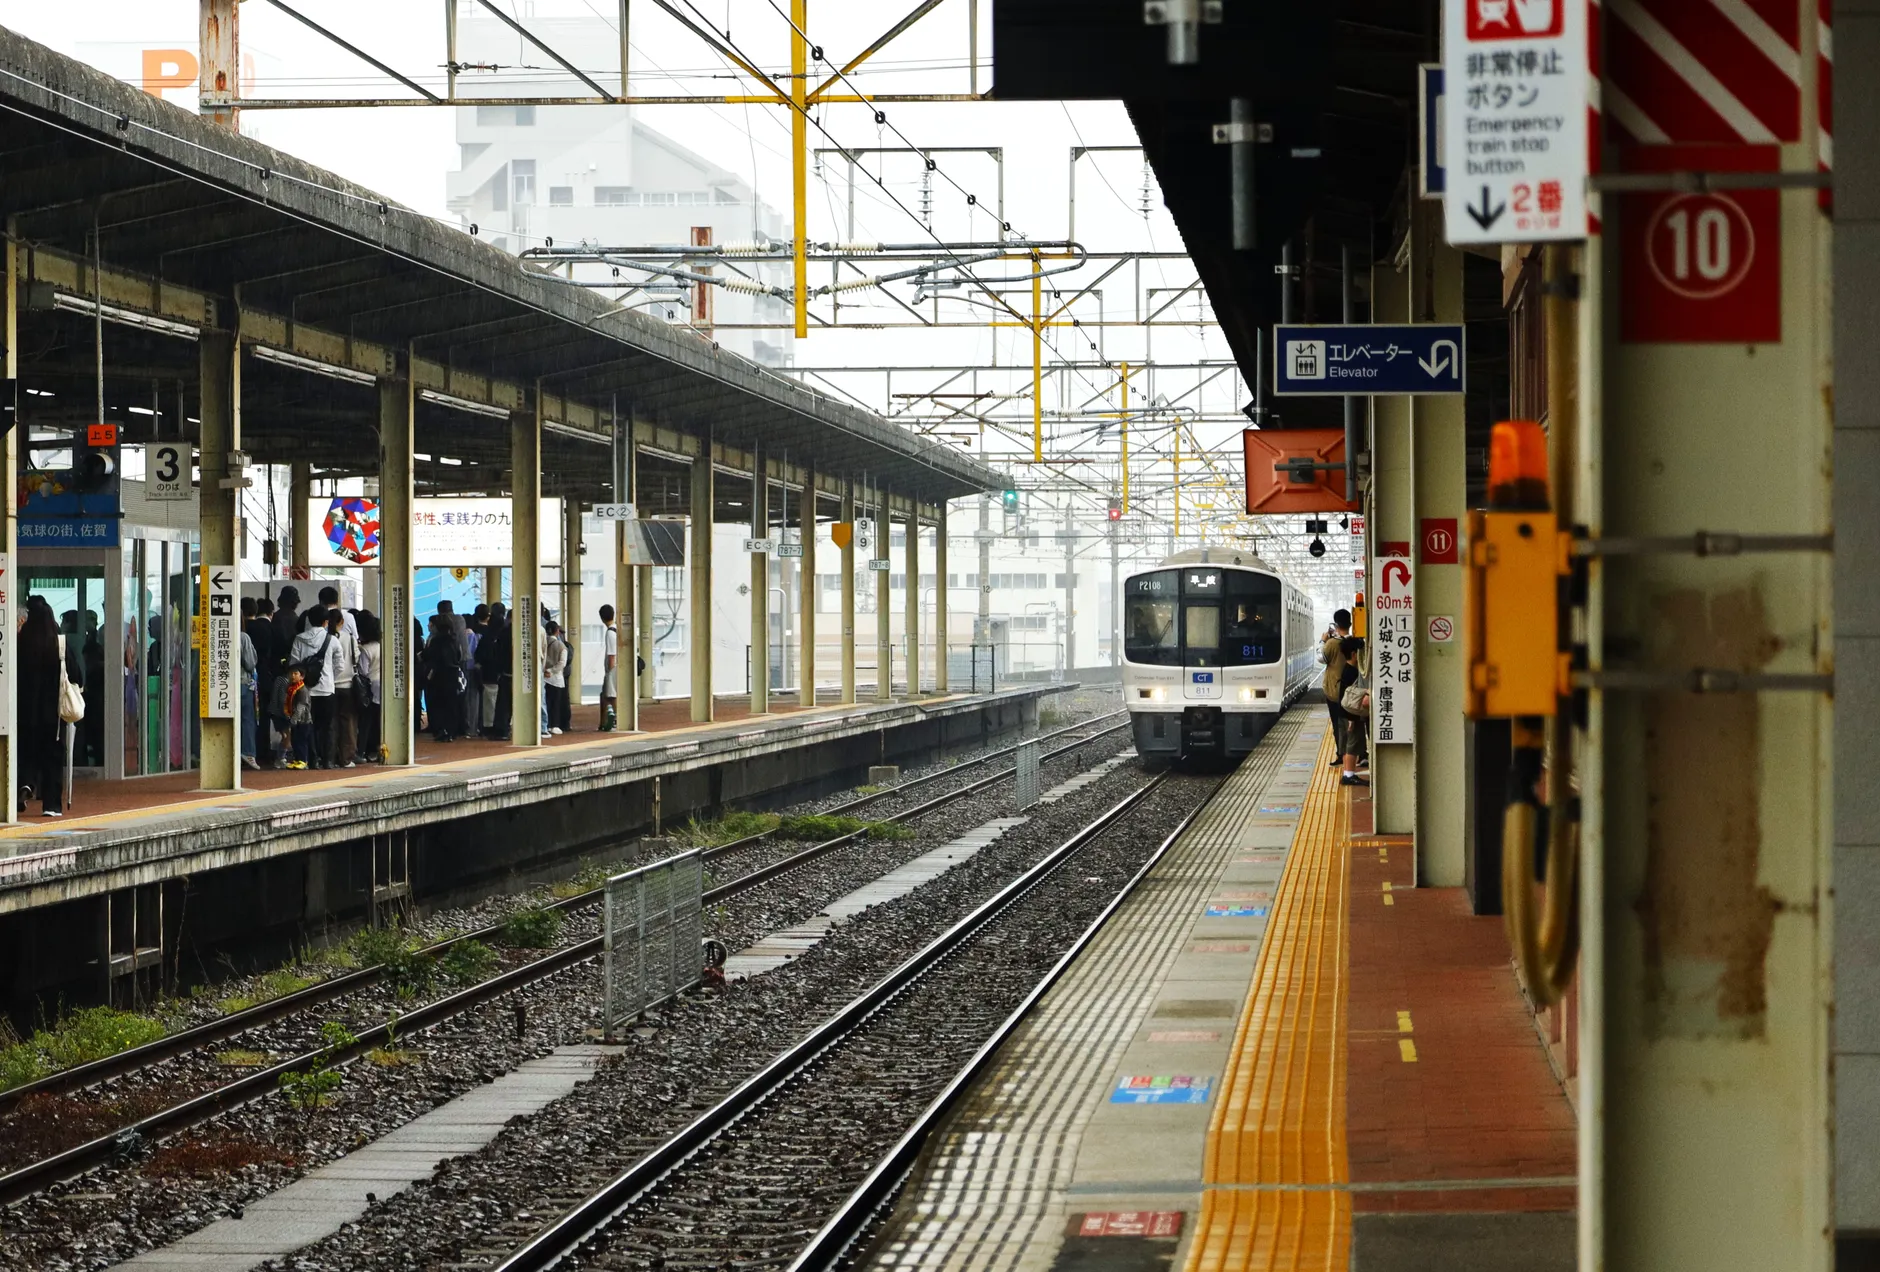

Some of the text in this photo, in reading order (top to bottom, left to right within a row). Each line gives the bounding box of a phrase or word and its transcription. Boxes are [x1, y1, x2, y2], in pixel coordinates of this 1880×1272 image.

[1466, 48, 1565, 77] 非常停止
[142, 49, 200, 98] P
[1466, 83, 1540, 109] ボタン
[1466, 116, 1564, 133] Emergency
[1466, 136, 1550, 153] train stop
[1466, 159, 1525, 175] button
[1666, 208, 1731, 281] 10
[1329, 343, 1413, 362] エレベーター
[1329, 365, 1379, 379] Elevator
[156, 447, 180, 482] 3
[156, 483, 180, 491] のりば
[619, 507, 628, 517] 2
[17, 524, 107, 537] 気球の街、佐賀
[861, 519, 868, 530] 9
[766, 541, 772, 550] 3
[860, 538, 867, 548] 9
[1432, 533, 1446, 550] 11
[780, 547, 802, 555] 787-7
[456, 568, 463, 579] 9
[982, 585, 991, 593] 12
[1139, 581, 1161, 591] P2108
[1242, 645, 1264, 656] 811
[217, 618, 231, 710] 自由席特急券うりば
[1197, 674, 1208, 682] CT
[1378, 615, 1393, 741] 小城・多久・唐津方面
[1195, 687, 1210, 695] 811
